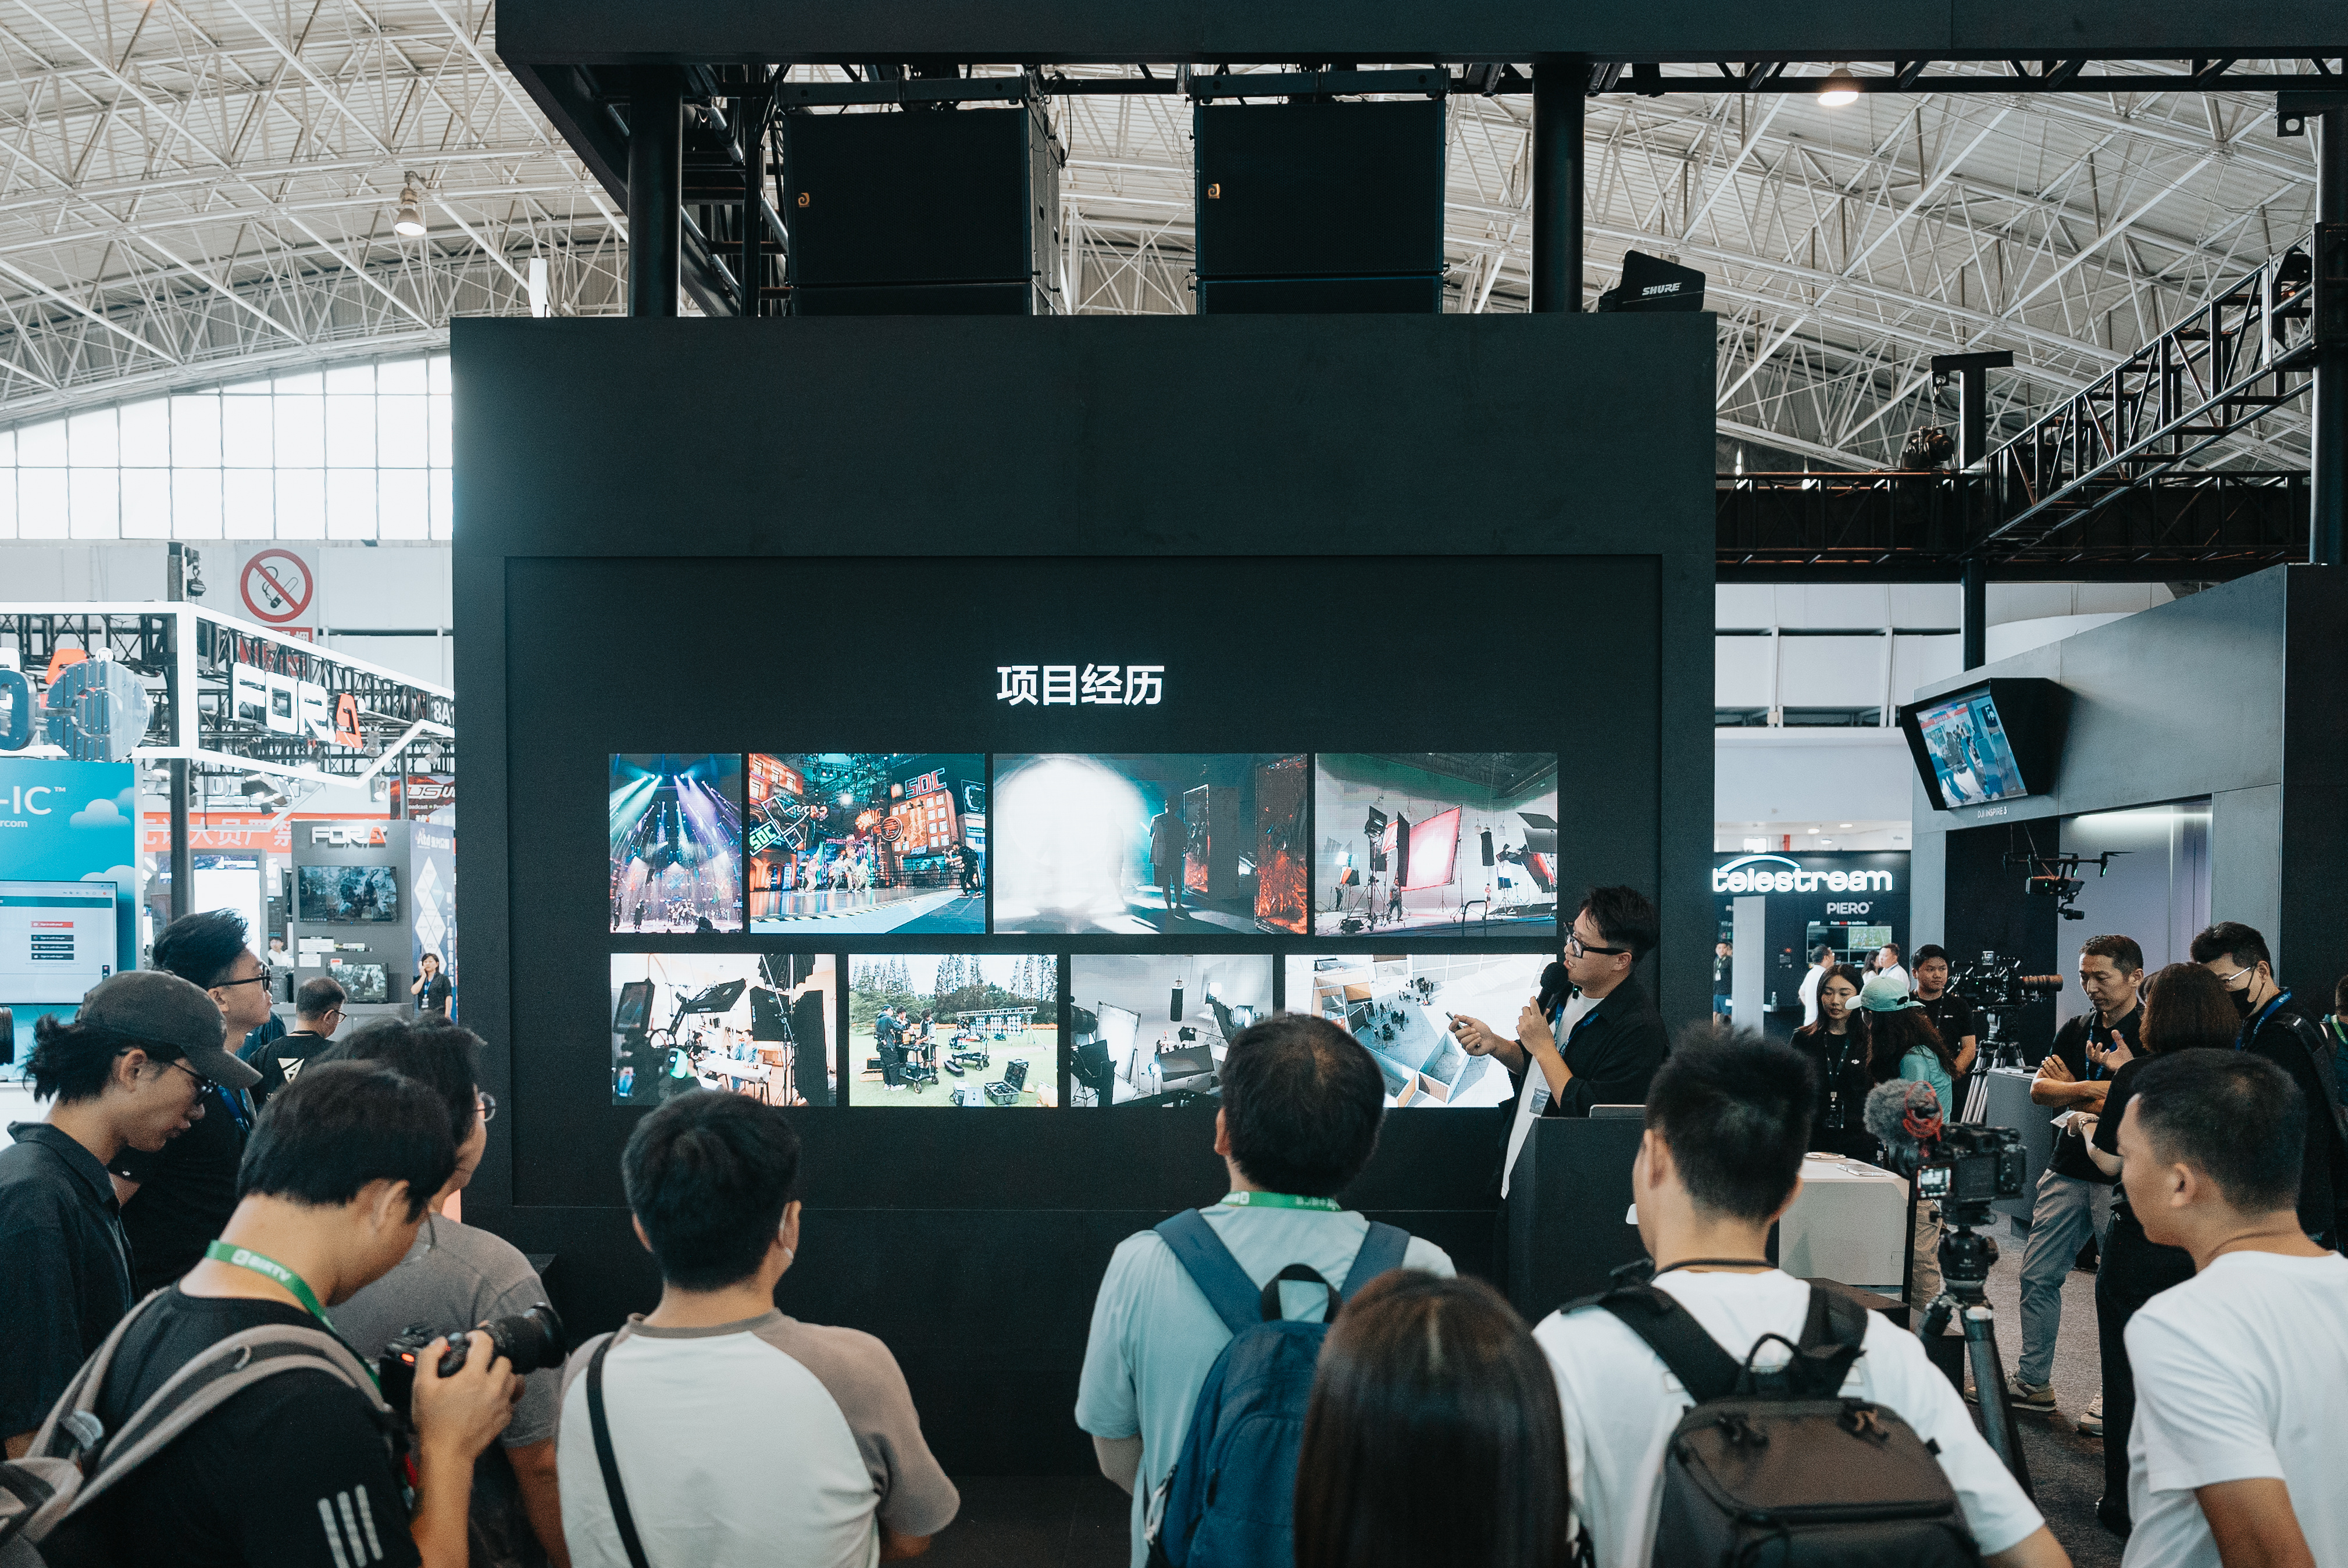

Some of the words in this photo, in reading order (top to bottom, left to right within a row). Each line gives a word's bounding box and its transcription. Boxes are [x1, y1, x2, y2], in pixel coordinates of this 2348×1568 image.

[1642, 282, 1682, 295] SHURE
[996, 663, 1165, 706] 项目经历
[1985, 806, 2003, 817] INSPIRE
[1712, 867, 1893, 892] telestream
